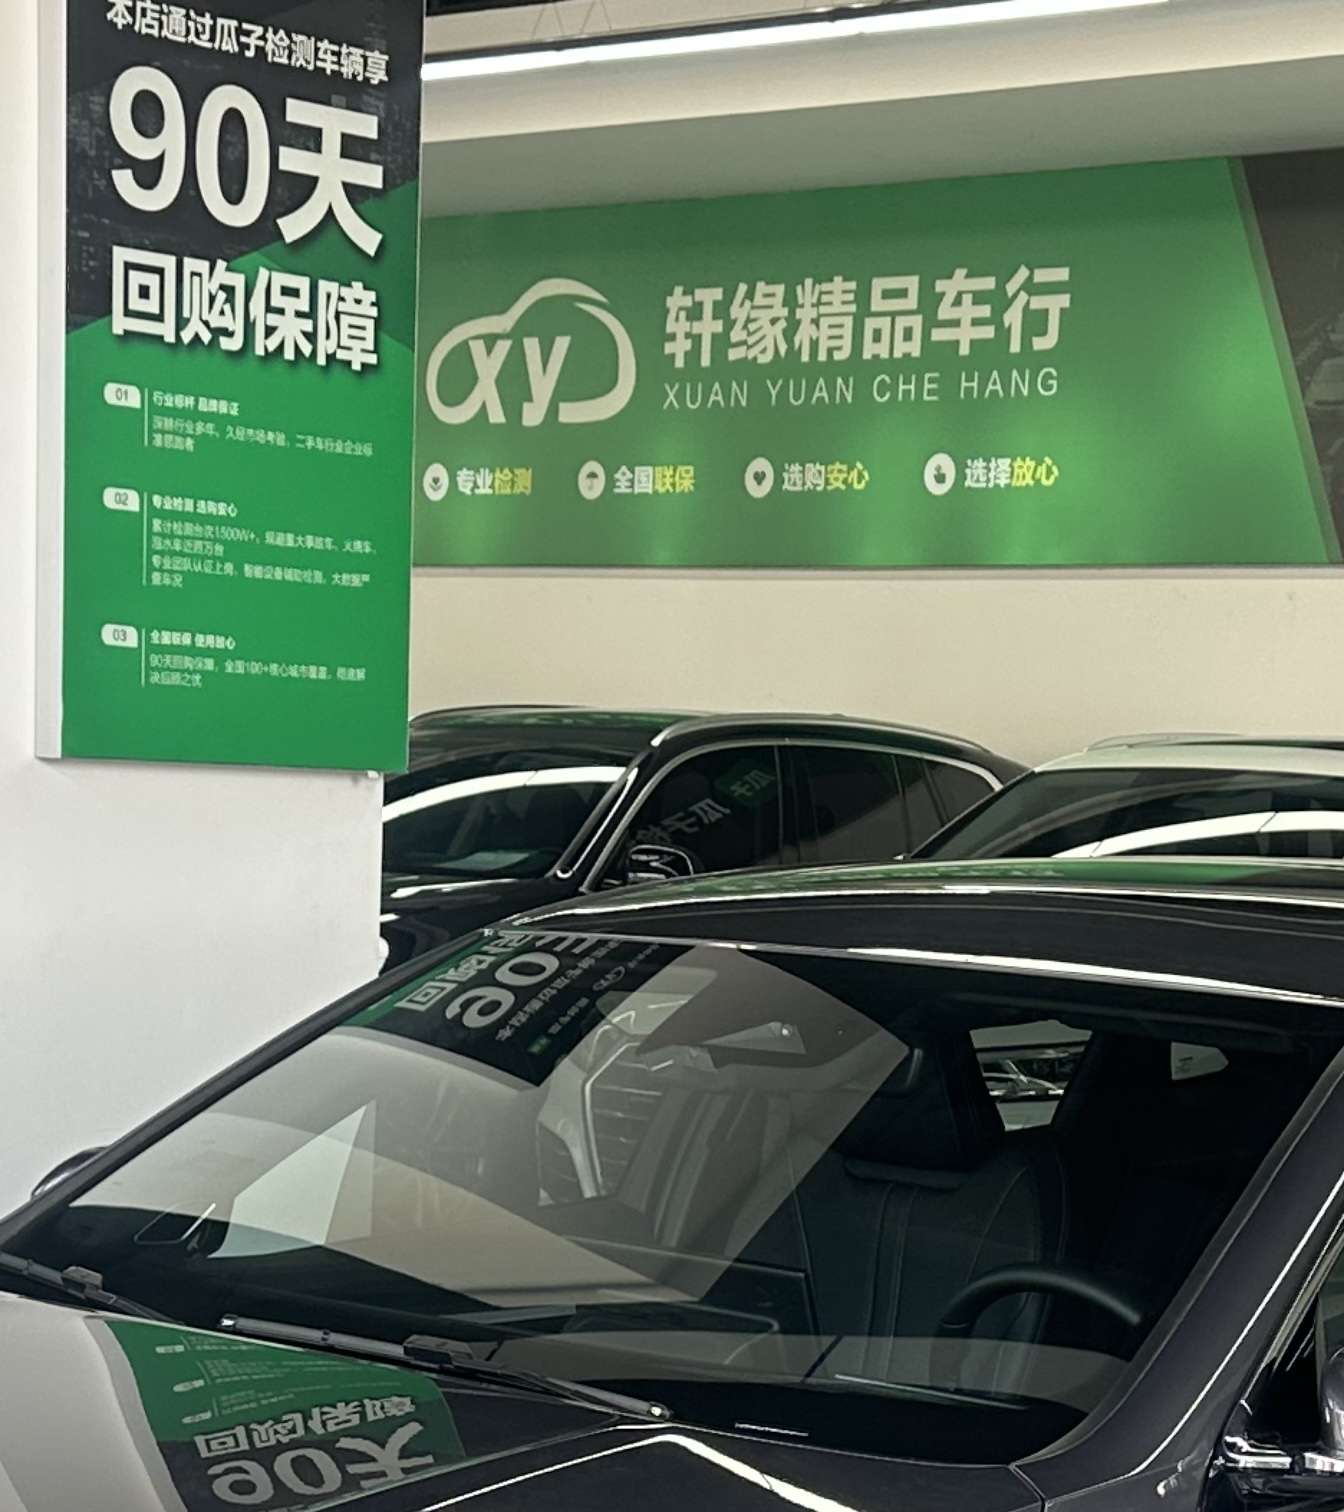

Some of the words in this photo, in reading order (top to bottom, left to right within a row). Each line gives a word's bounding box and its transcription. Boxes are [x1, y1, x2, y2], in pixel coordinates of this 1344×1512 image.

[106, 0, 389, 84] 本店通过瓜子检测车辆享
[109, 65, 384, 257] 90天
[111, 246, 378, 371] 回购保障
[663, 264, 1072, 370] 轩缘精品车行
[116, 388, 129, 401] 01
[663, 380, 748, 410] XUAN
[766, 376, 854, 406] YUAN
[872, 372, 940, 403] CHE
[960, 367, 1058, 399] HANG
[456, 467, 533, 496] 专业检测
[613, 465, 696, 494] 全国联保
[782, 461, 870, 492] 选购安心
[964, 456, 1060, 488] 选择放心
[114, 492, 129, 506] 02
[113, 629, 127, 641] 03
